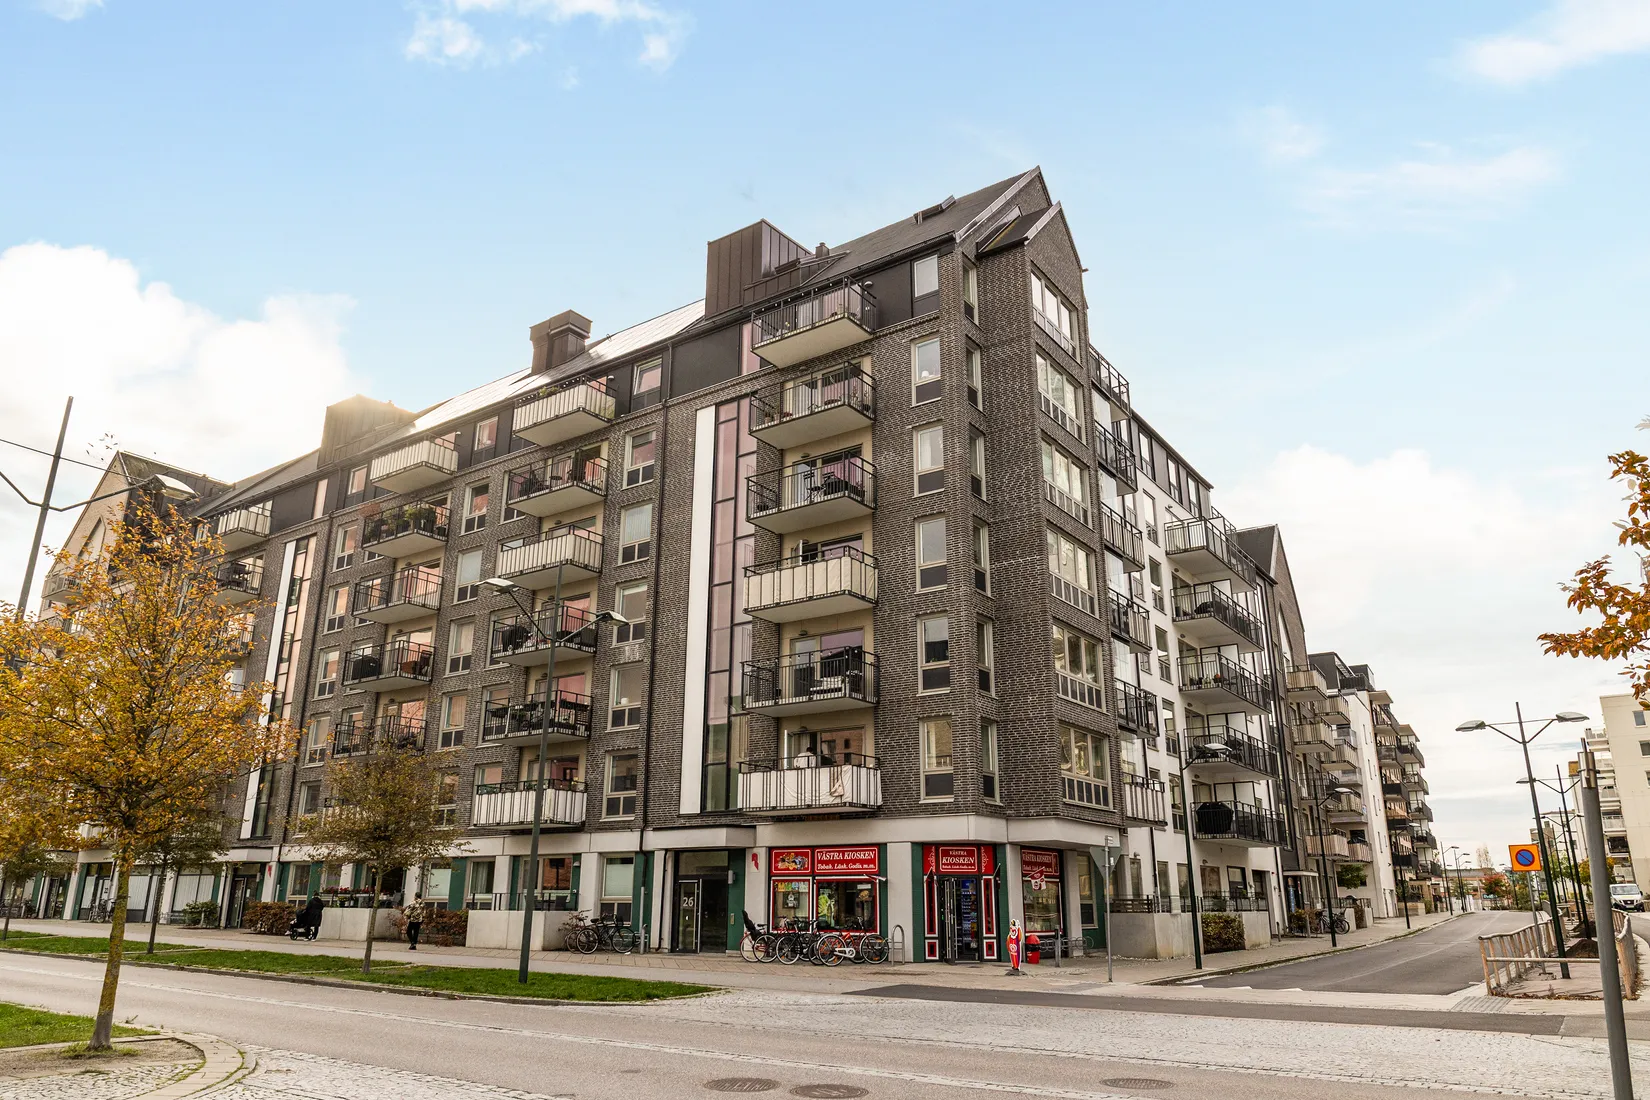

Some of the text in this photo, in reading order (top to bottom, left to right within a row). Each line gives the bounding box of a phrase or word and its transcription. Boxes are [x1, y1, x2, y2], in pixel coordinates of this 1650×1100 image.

[817, 851, 875, 861] VÄSTRA KIOSKEN
[942, 856, 975, 864] KIOSKEN
[682, 896, 694, 907] 26
